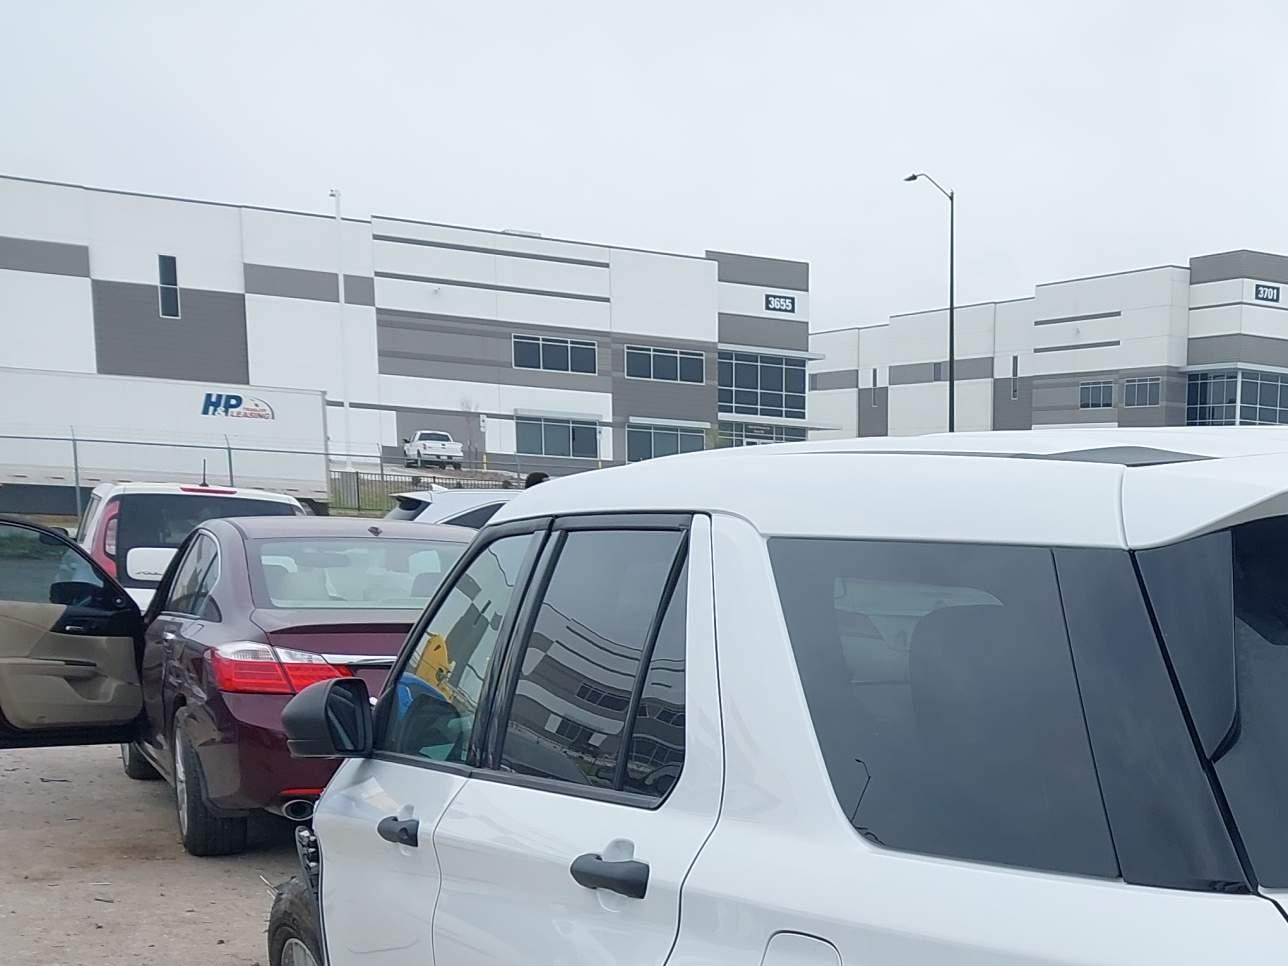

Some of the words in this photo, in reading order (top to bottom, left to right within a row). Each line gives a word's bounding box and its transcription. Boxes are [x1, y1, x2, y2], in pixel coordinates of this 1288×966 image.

[1257, 286, 1277, 300] 3701
[768, 296, 792, 310] 3655
[202, 393, 243, 416] HP
